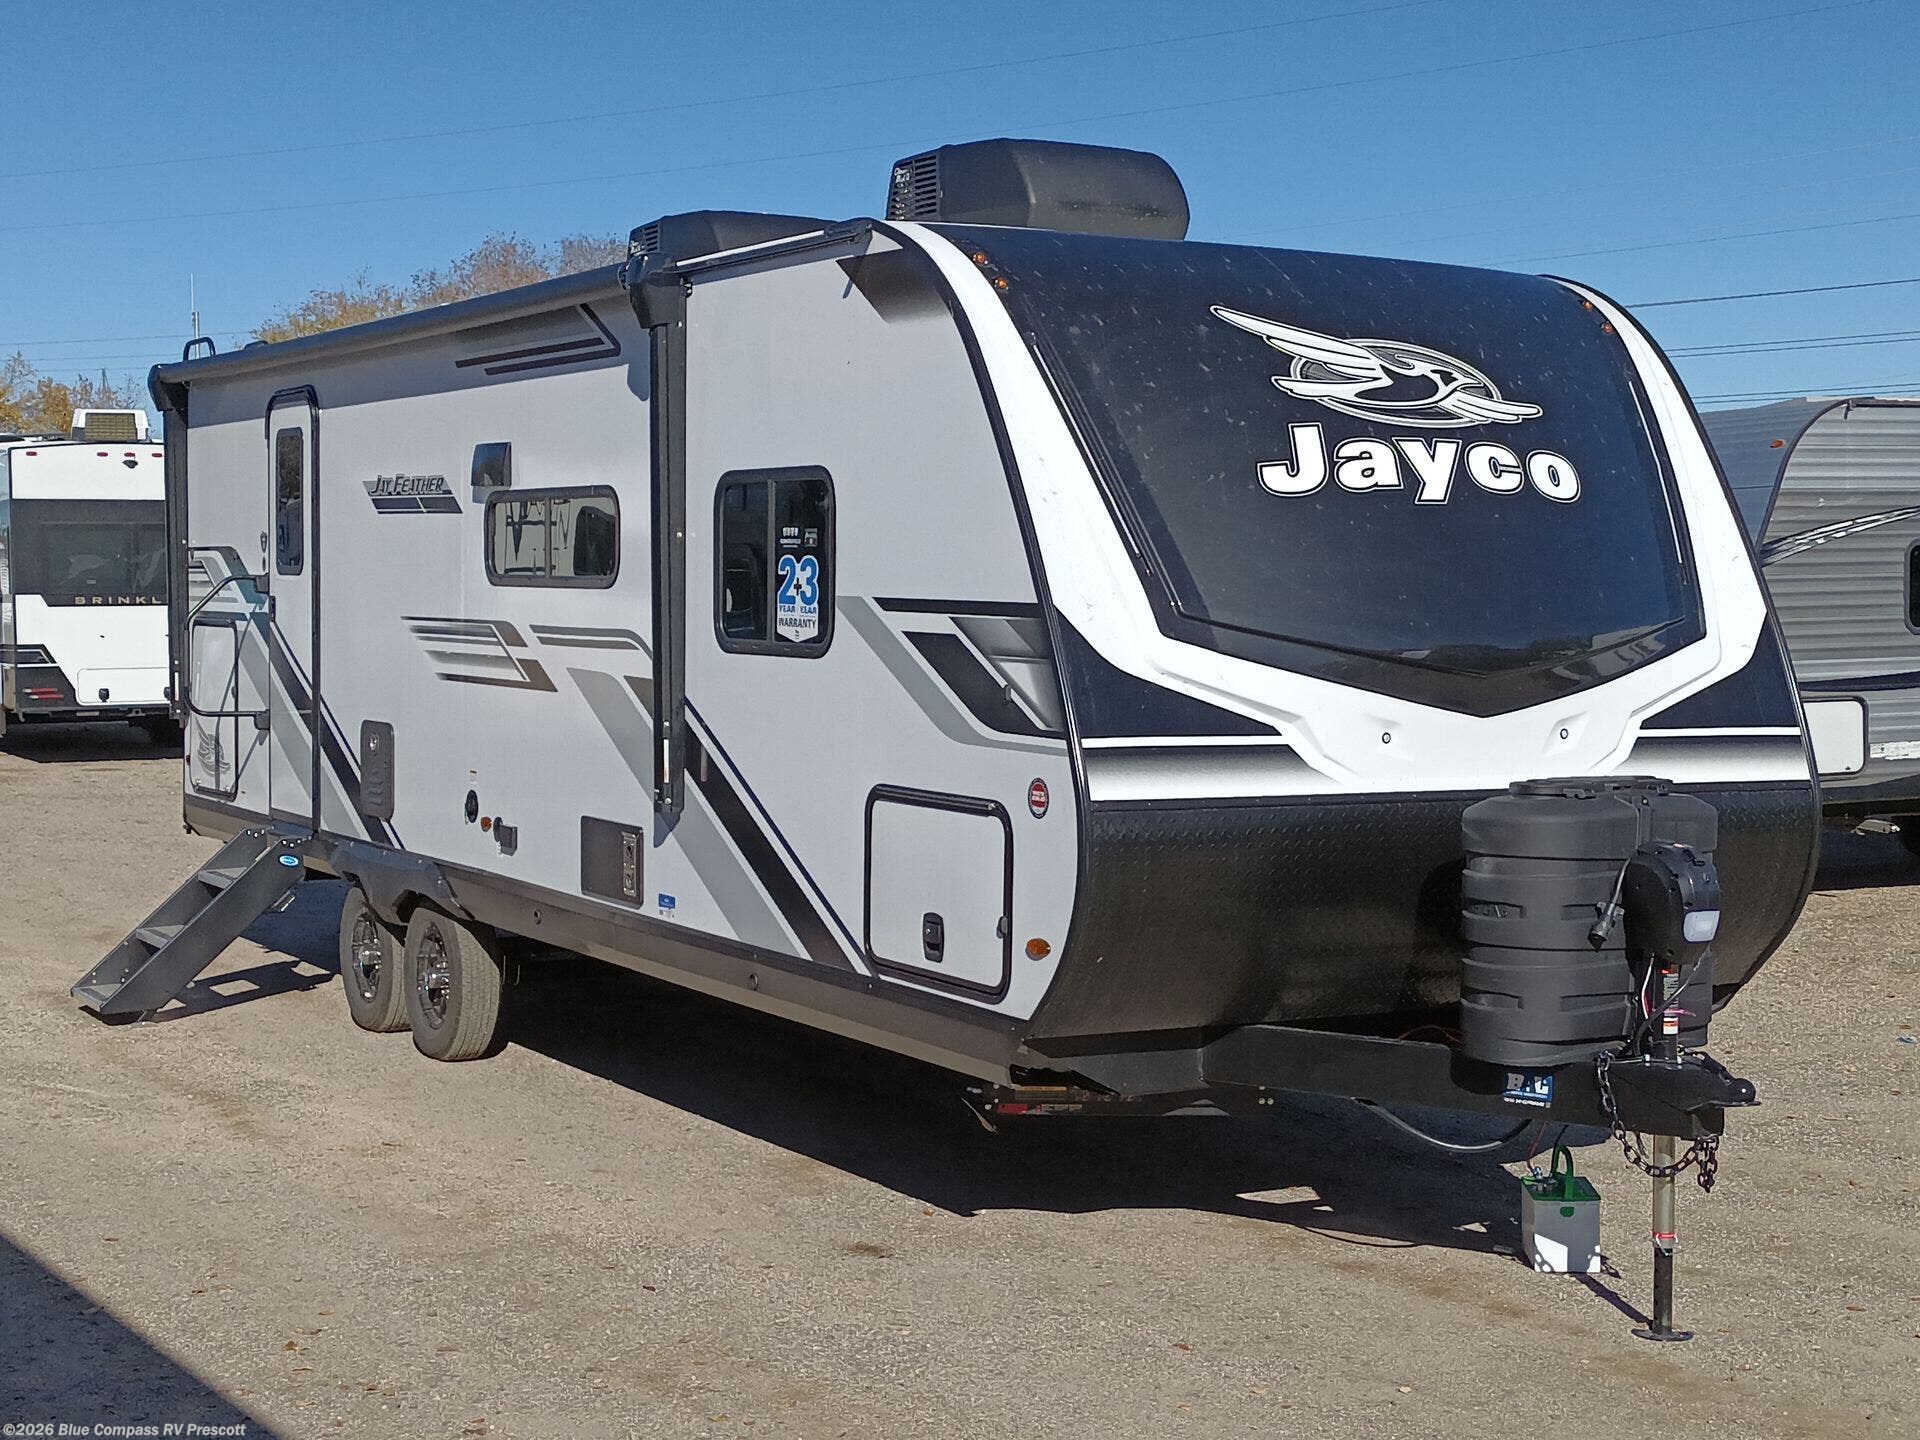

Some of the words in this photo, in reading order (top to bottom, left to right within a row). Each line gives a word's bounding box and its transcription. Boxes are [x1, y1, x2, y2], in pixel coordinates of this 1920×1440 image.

[1256, 422, 1581, 504] Jayco
[779, 605, 795, 613] YEAR
[800, 606, 817, 614] YEAR
[778, 617, 817, 629] WARRANTY
